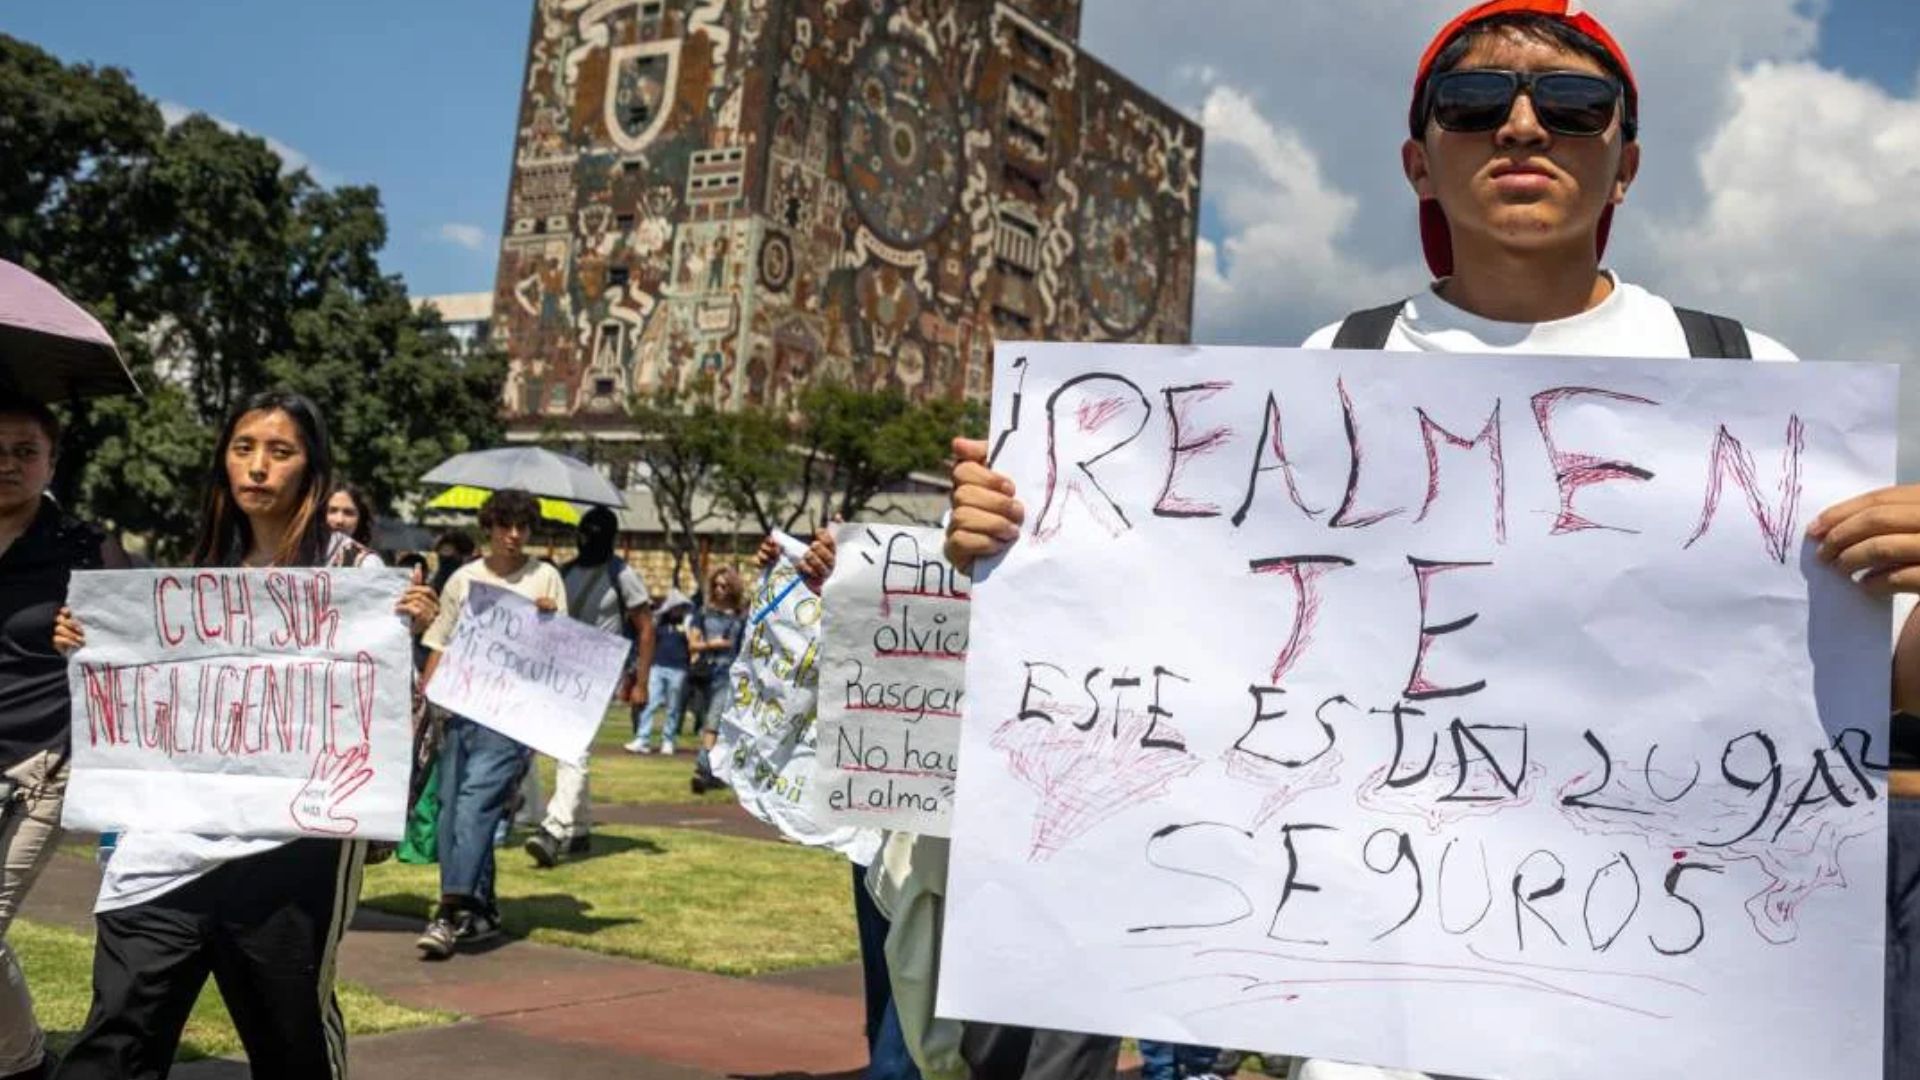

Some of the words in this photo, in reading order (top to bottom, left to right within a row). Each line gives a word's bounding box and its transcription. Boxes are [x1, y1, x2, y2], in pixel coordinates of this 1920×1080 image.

[153, 573, 255, 648] CCH
[265, 571, 340, 649] SUR
[1249, 555, 1492, 699] TE
[836, 725, 888, 771] No
[1018, 662, 1191, 753] ESTE
[1234, 684, 1360, 768] ES
[828, 778, 852, 811] el
